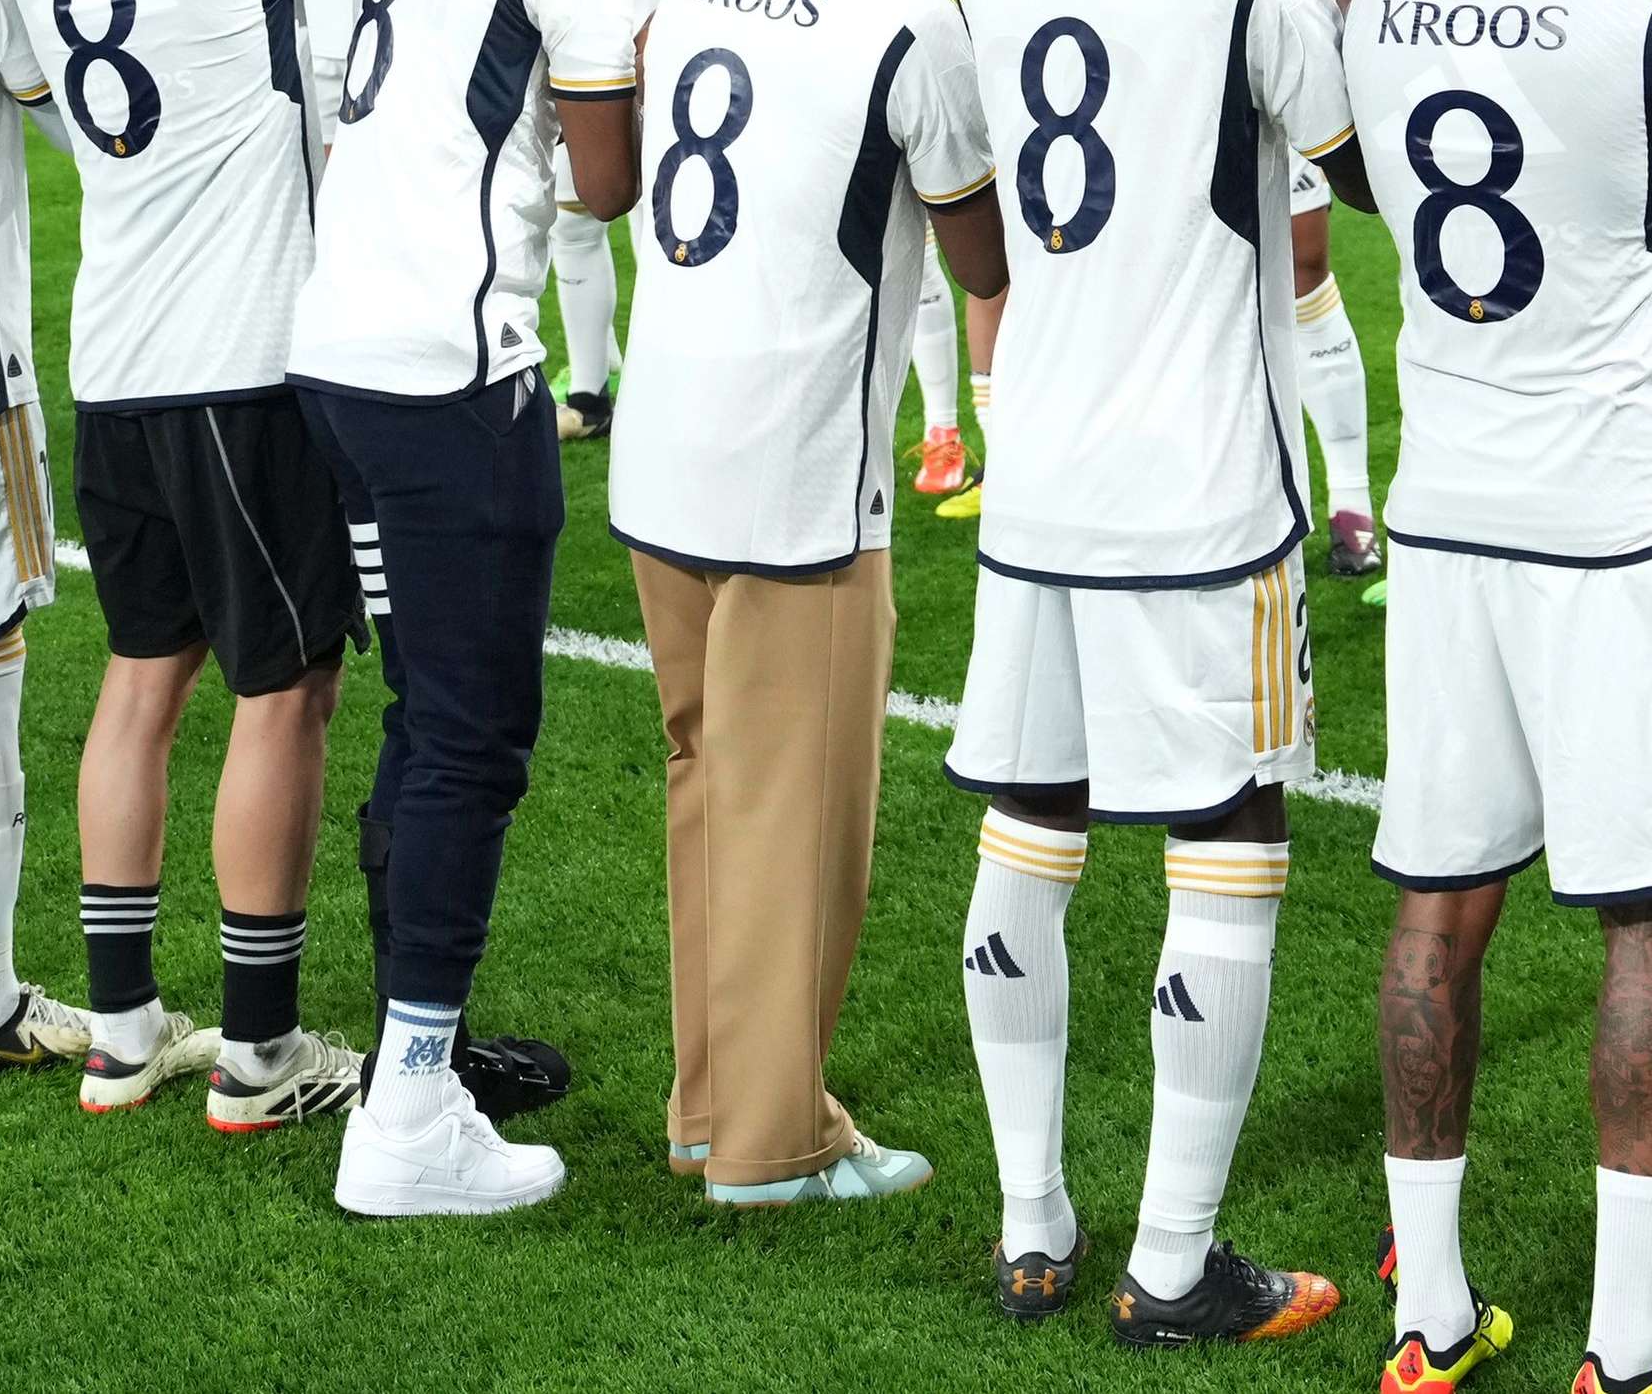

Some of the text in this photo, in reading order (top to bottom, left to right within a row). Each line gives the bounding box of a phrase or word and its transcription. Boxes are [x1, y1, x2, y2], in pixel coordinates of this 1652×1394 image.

[1016, 16, 1116, 255] 8
[1376, 0, 1570, 52] KROOS
[652, 47, 754, 268] 8
[1405, 89, 1545, 324] 8
